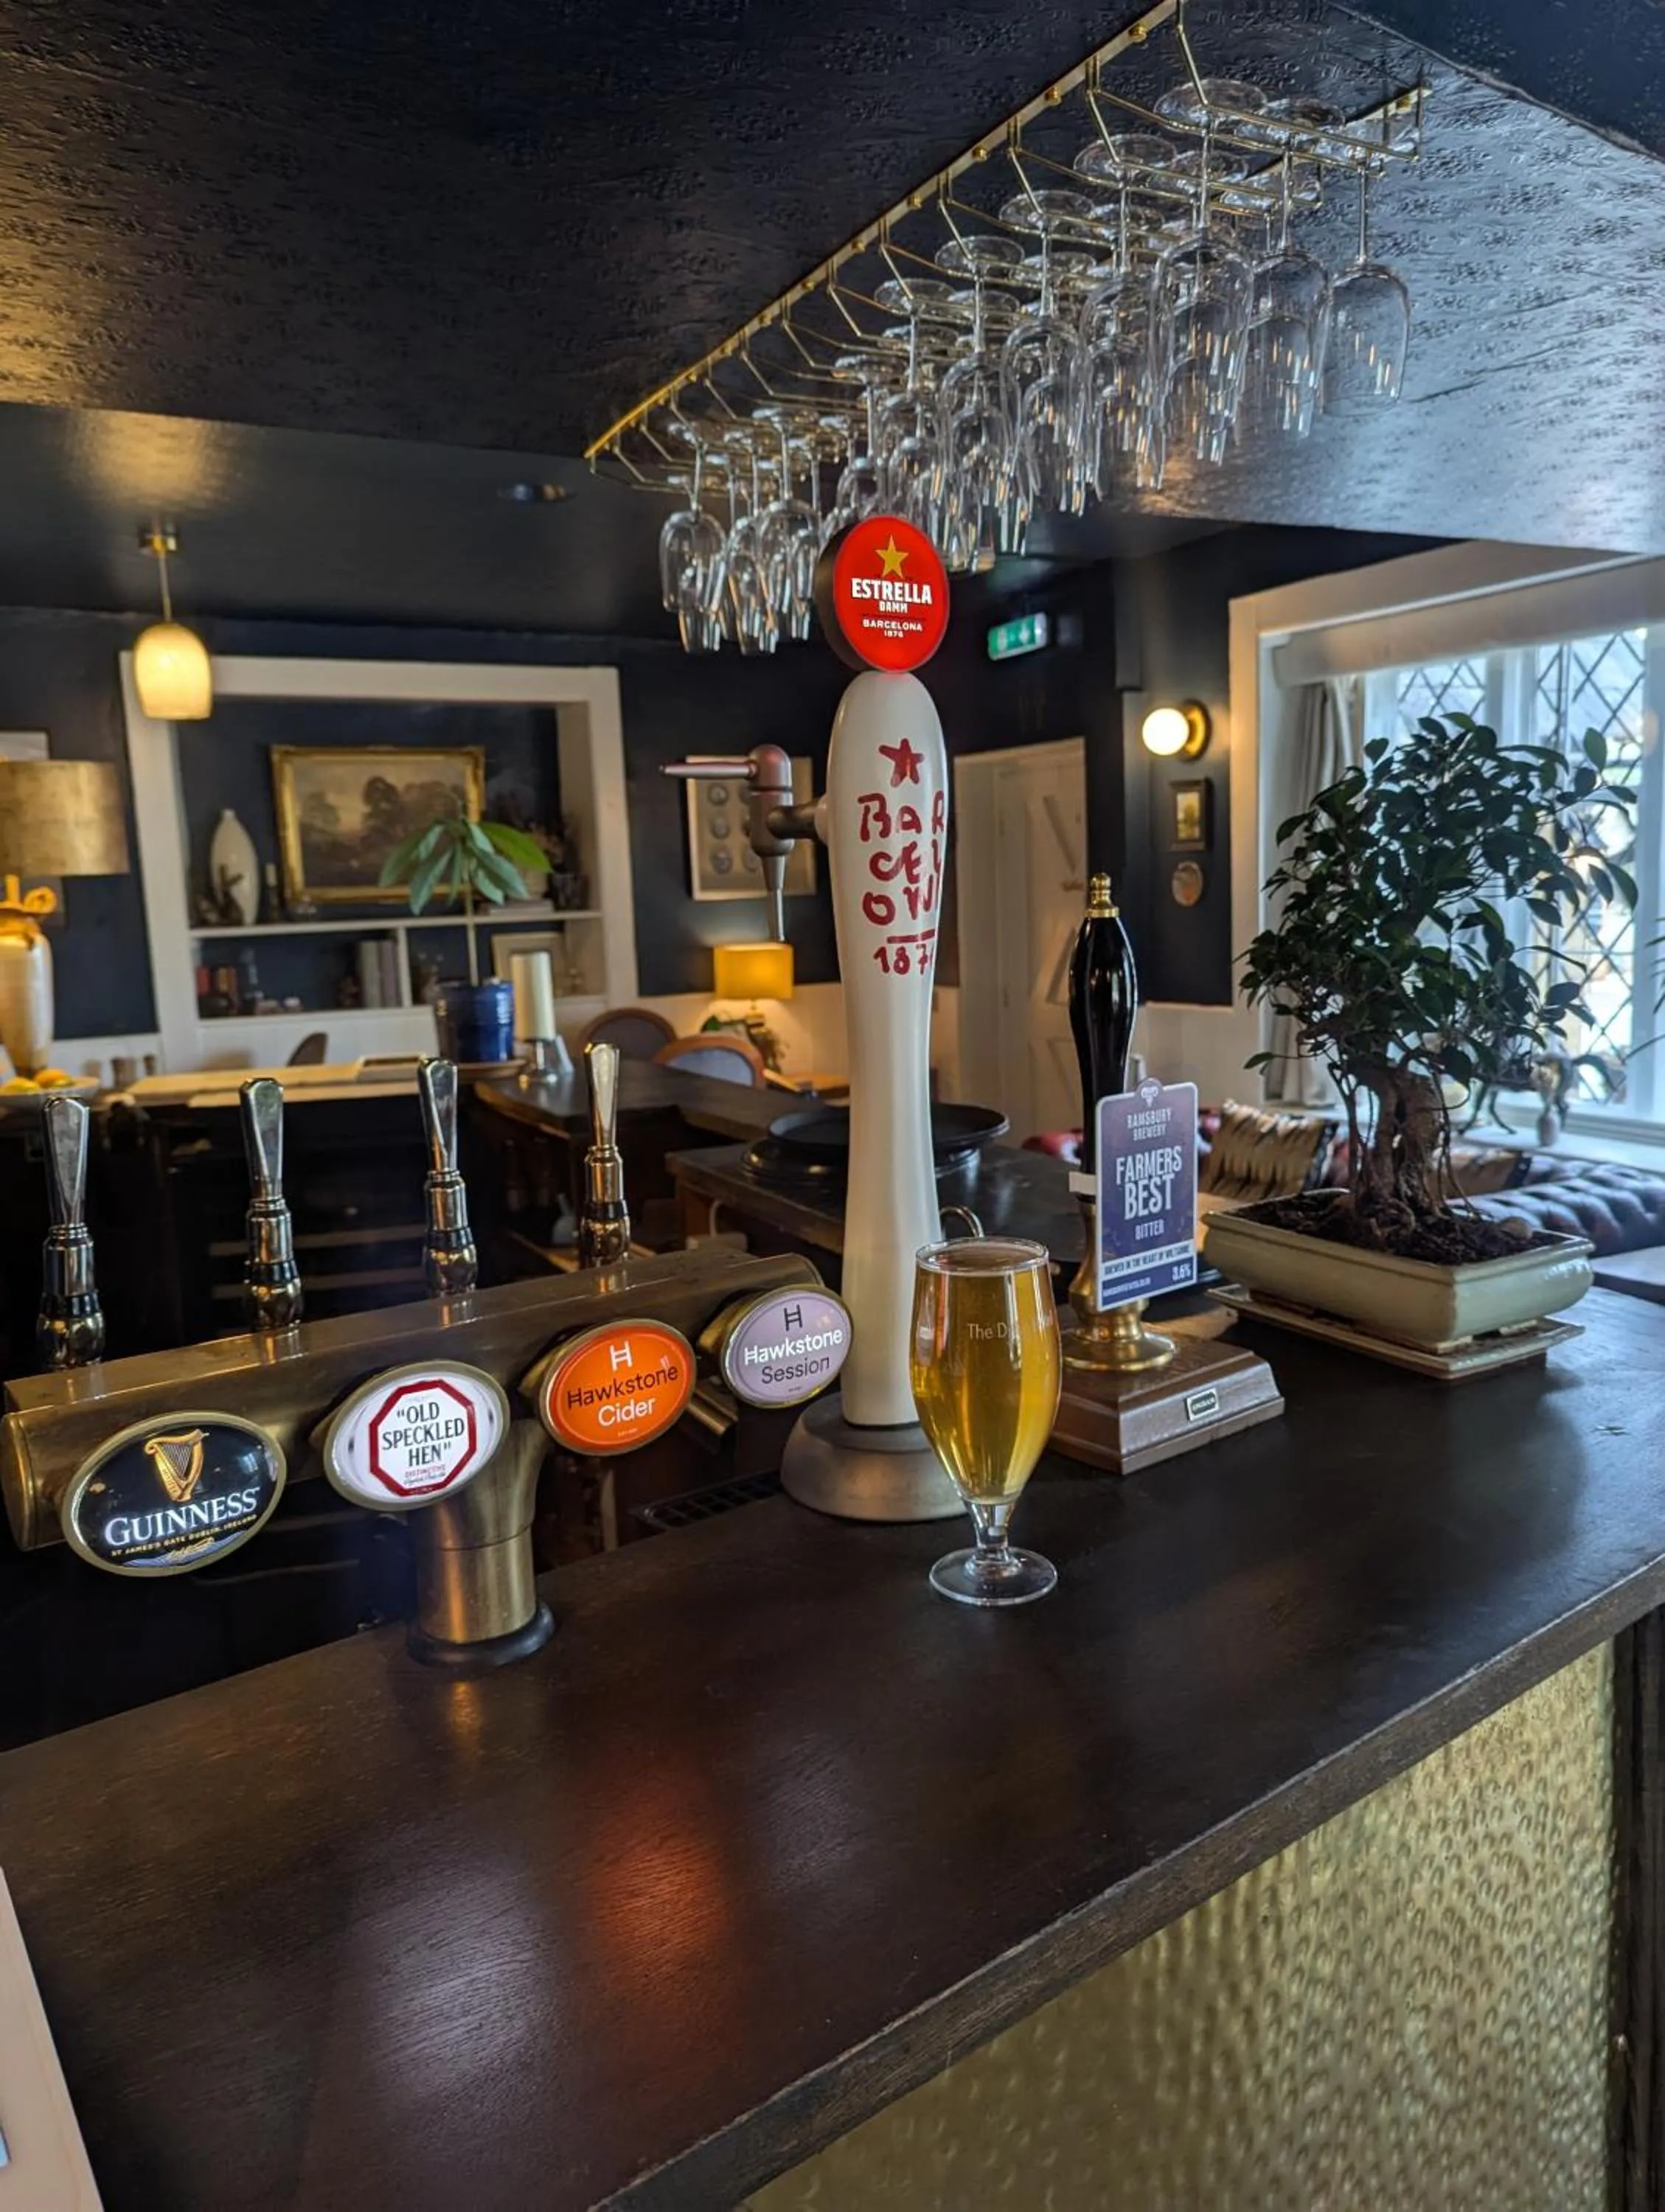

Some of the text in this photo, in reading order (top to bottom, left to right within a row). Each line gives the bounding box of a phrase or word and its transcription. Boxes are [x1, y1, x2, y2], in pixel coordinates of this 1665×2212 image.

[851, 577, 932, 604] ESTRELLA
[879, 601, 908, 613] DAMM
[863, 619, 922, 631] BARCELONA
[873, 944, 933, 975] 187
[1116, 1145, 1182, 1185] FARMERS
[1125, 1173, 1175, 1220] BEST
[1135, 1219, 1164, 1240] BITTER
[967, 1323, 993, 1340] The
[744, 1329, 843, 1366] Hawkstone
[762, 1357, 830, 1384] Session
[567, 1366, 678, 1409] Hawkstone
[598, 1398, 656, 1426] Cider
[382, 1418, 465, 1450] SPECKLED
[104, 1486, 260, 1546] GUINNESS
